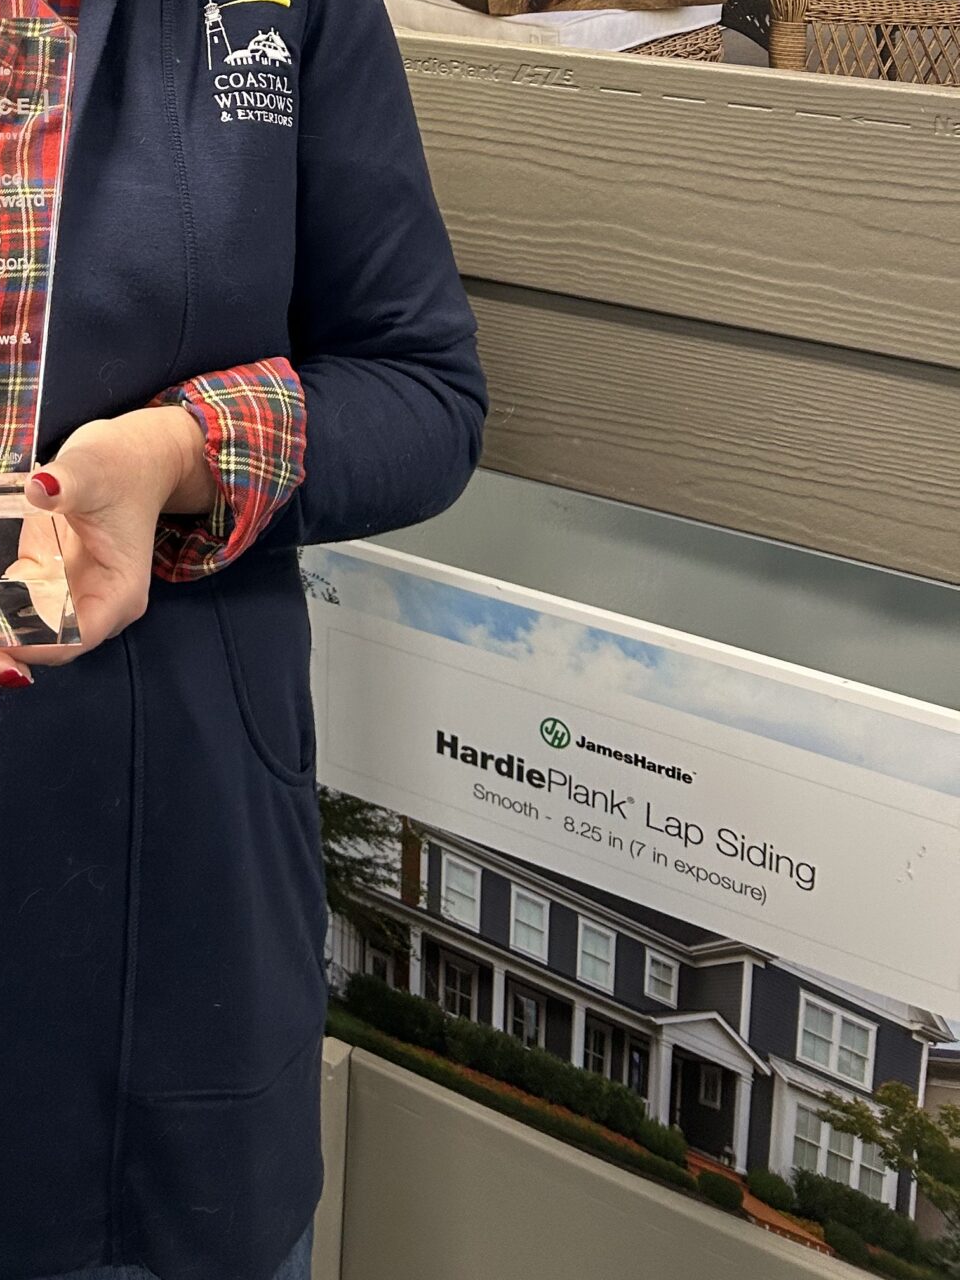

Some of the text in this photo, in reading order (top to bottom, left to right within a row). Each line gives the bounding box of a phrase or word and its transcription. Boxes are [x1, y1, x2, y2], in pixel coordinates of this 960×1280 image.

[214, 72, 293, 94] COASTAL
[214, 91, 294, 113] WINDOWS
[221, 109, 294, 127] & EXTERIORS
[21, 332, 32, 345] &
[473, 782, 539, 820] Smooth
[563, 816, 603, 843] 8.25
[608, 832, 624, 851] in
[629, 838, 647, 859] (7
[652, 845, 669, 867] in
[674, 856, 768, 907] exposure)
[646, 802, 705, 848] Lap
[716, 827, 817, 891] Siding
